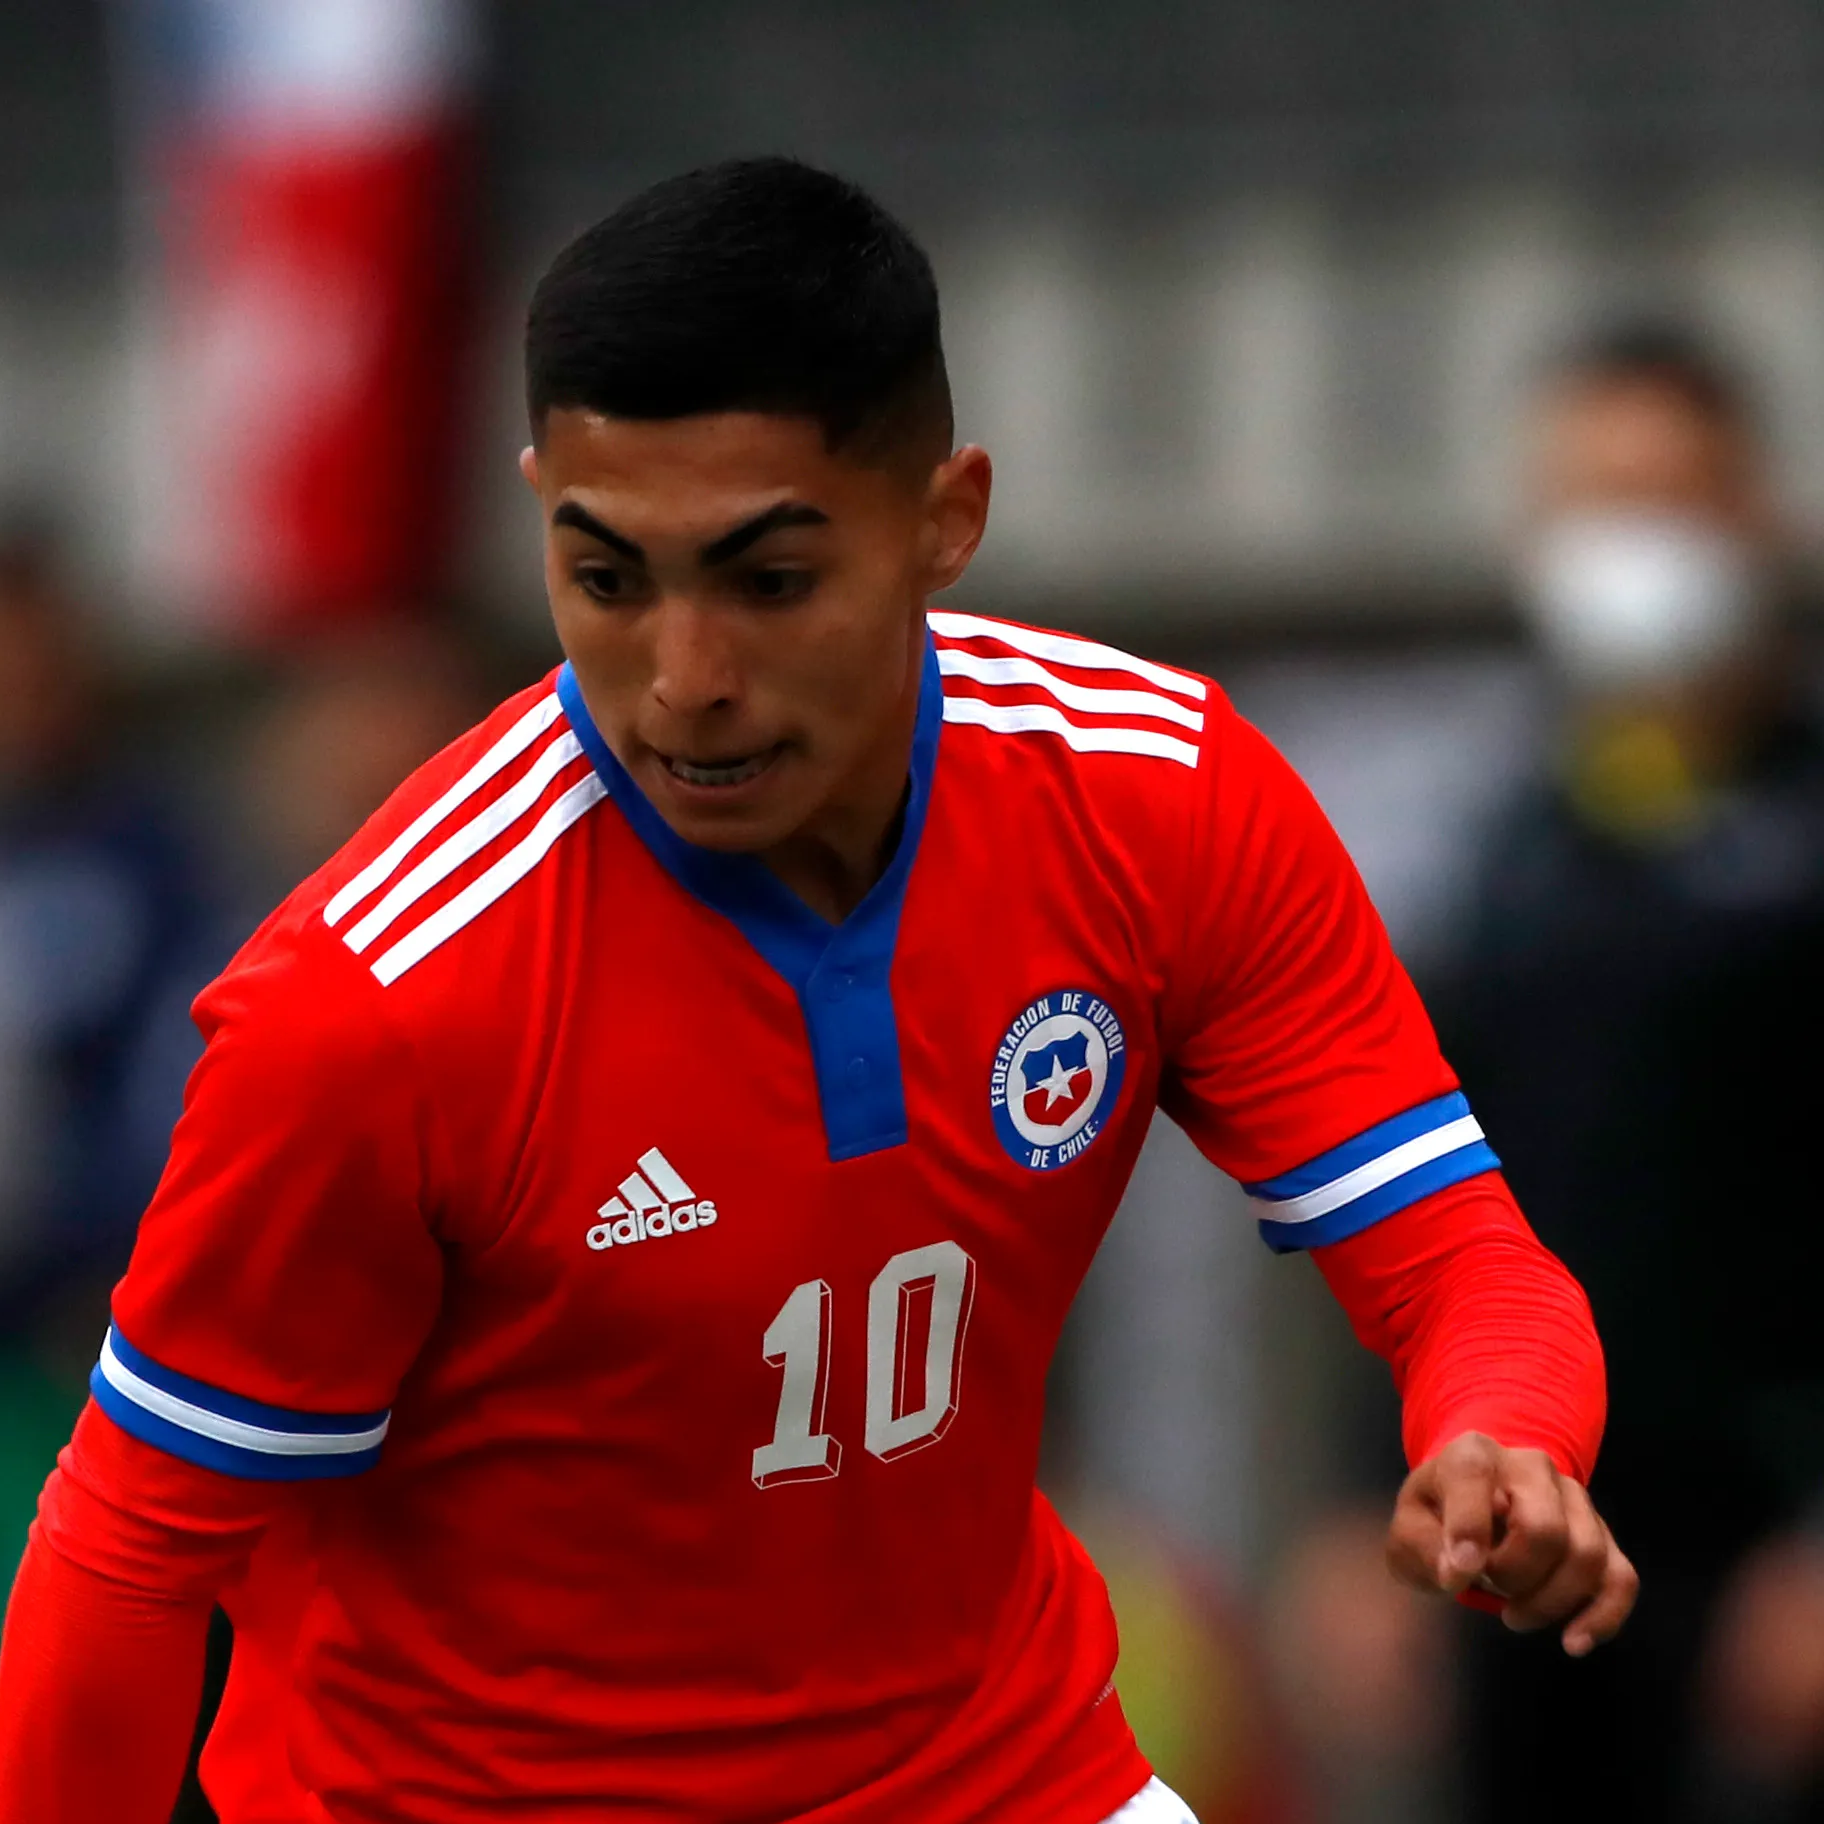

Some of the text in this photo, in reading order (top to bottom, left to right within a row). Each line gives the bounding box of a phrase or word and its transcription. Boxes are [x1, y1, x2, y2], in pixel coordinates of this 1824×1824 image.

[991, 993, 1125, 1108] FEDERACION DE FUTBOL
[1030, 1126, 1097, 1168] DE CHILE
[586, 1200, 718, 1251] adidas
[751, 1240, 977, 1490] 10
